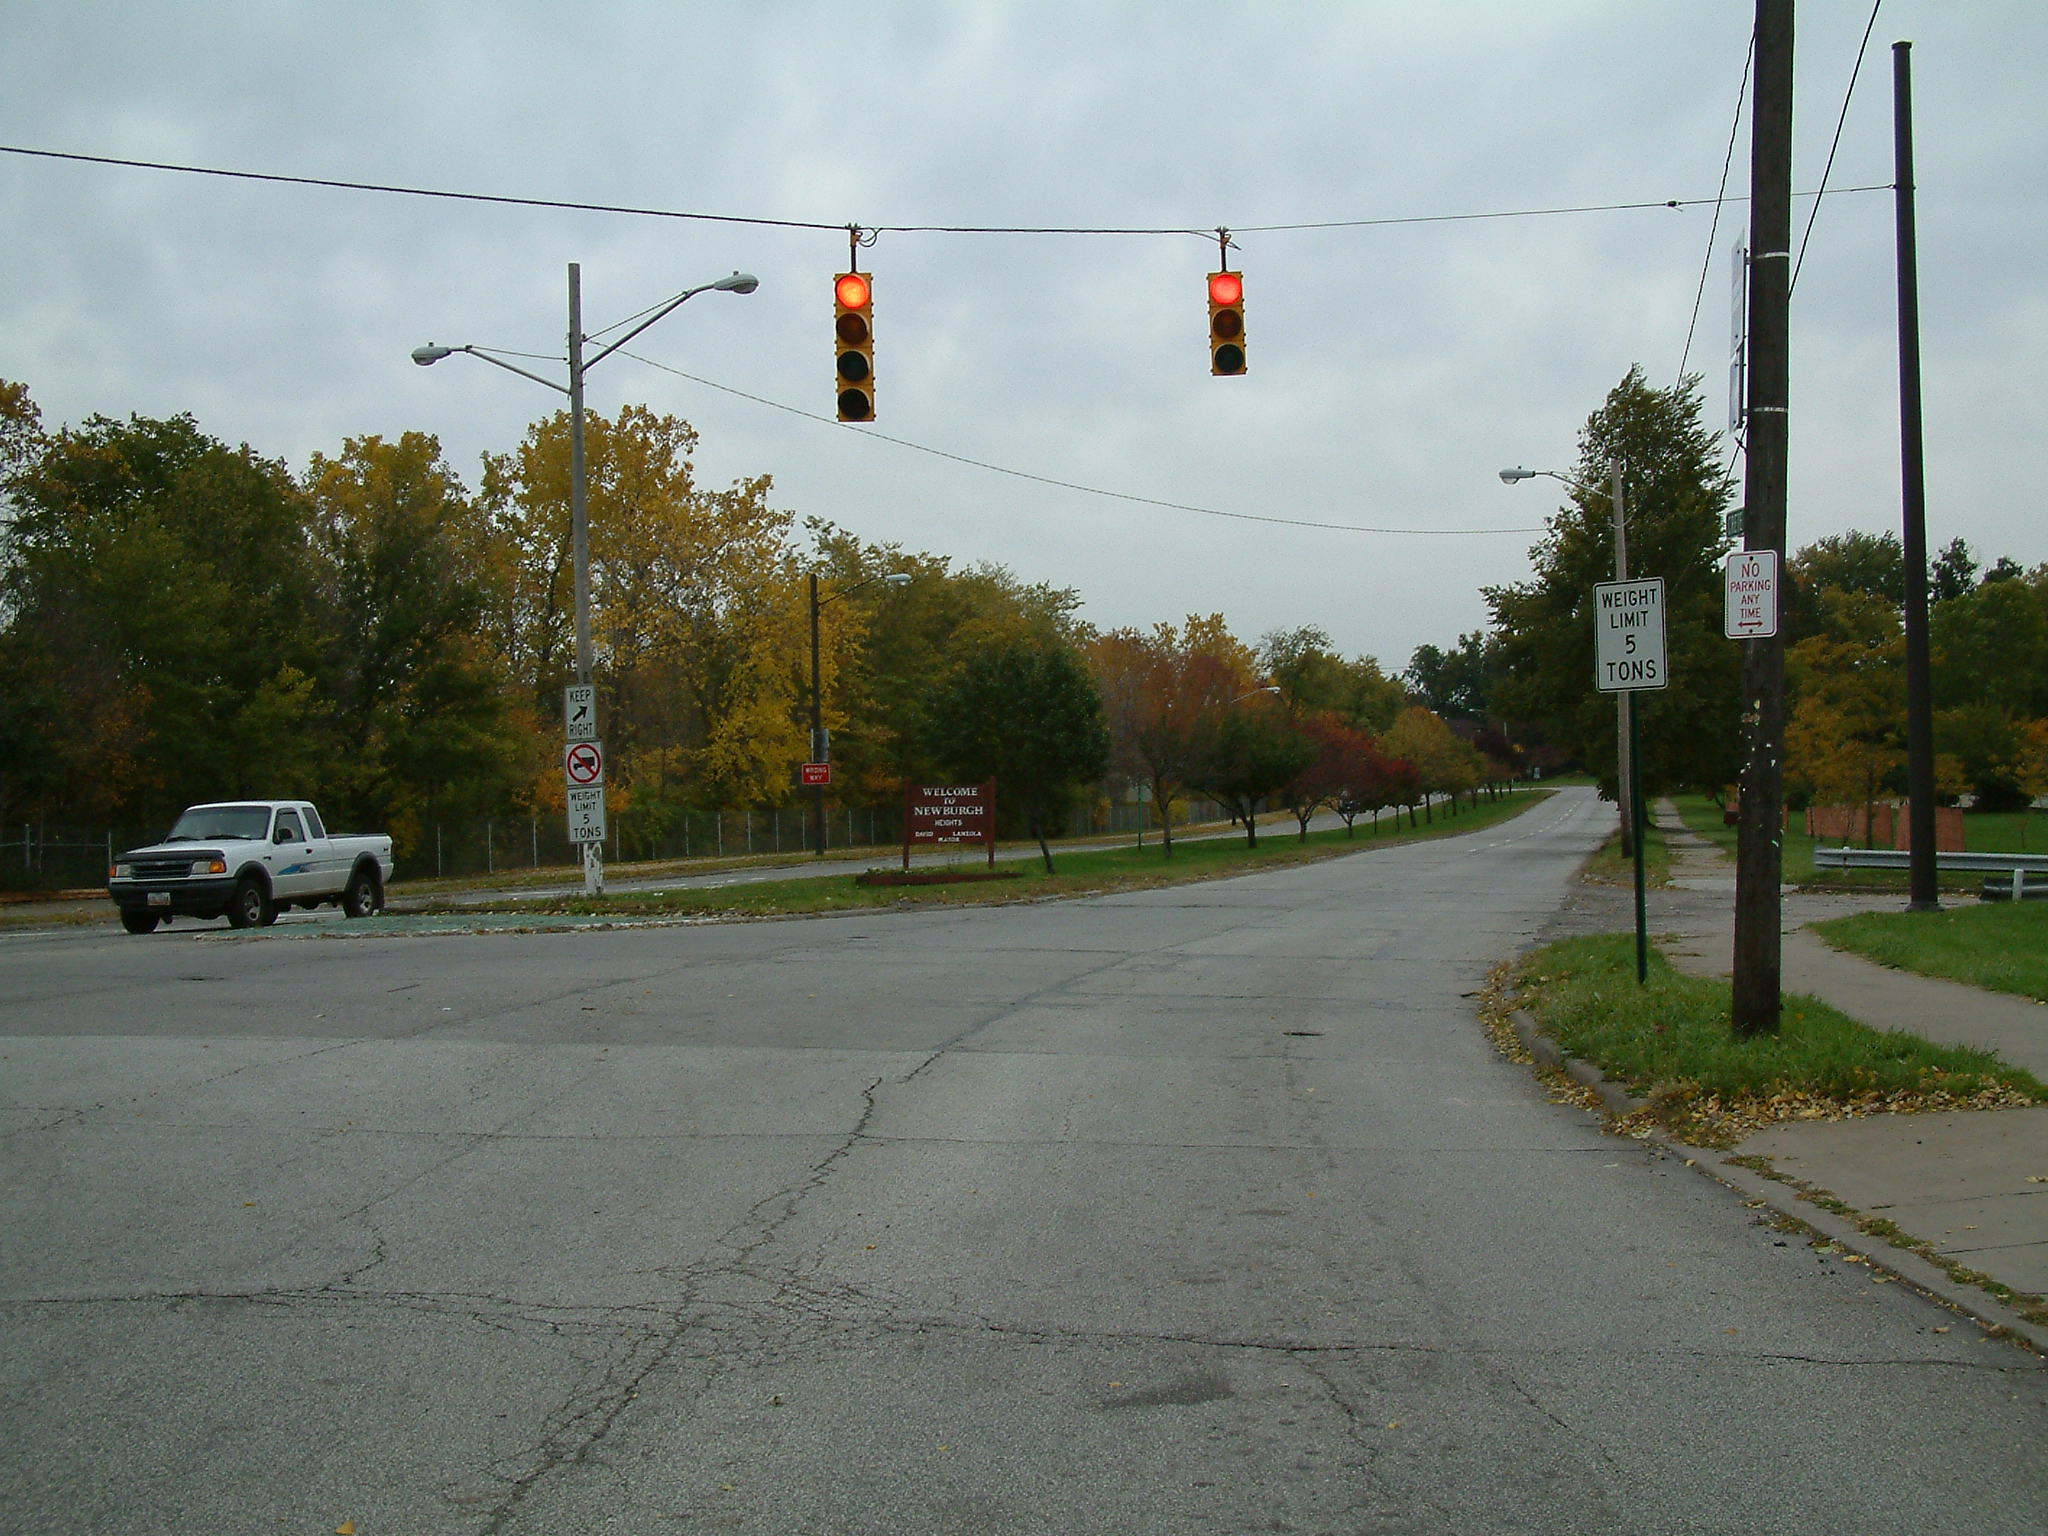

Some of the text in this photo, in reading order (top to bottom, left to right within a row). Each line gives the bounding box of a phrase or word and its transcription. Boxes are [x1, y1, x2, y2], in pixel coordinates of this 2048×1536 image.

[1741, 563, 1760, 578] NO
[1730, 580, 1771, 593] PARKING
[1602, 588, 1657, 609] WEIGHT
[1741, 594, 1760, 605] ANY
[1740, 607, 1761, 619] TIME
[1611, 611, 1648, 629] LIMIT
[1625, 634, 1636, 655] 5
[1607, 659, 1656, 682] TONS
[569, 689, 591, 702] KEEP
[569, 722, 592, 736] RIGHT
[570, 790, 601, 801] WEIGHT
[923, 787, 978, 797] WELCOME
[575, 802, 596, 812] LIMIT
[914, 806, 984, 816] NEWBURGH
[583, 813, 590, 825] 5
[573, 826, 602, 839] TONS
